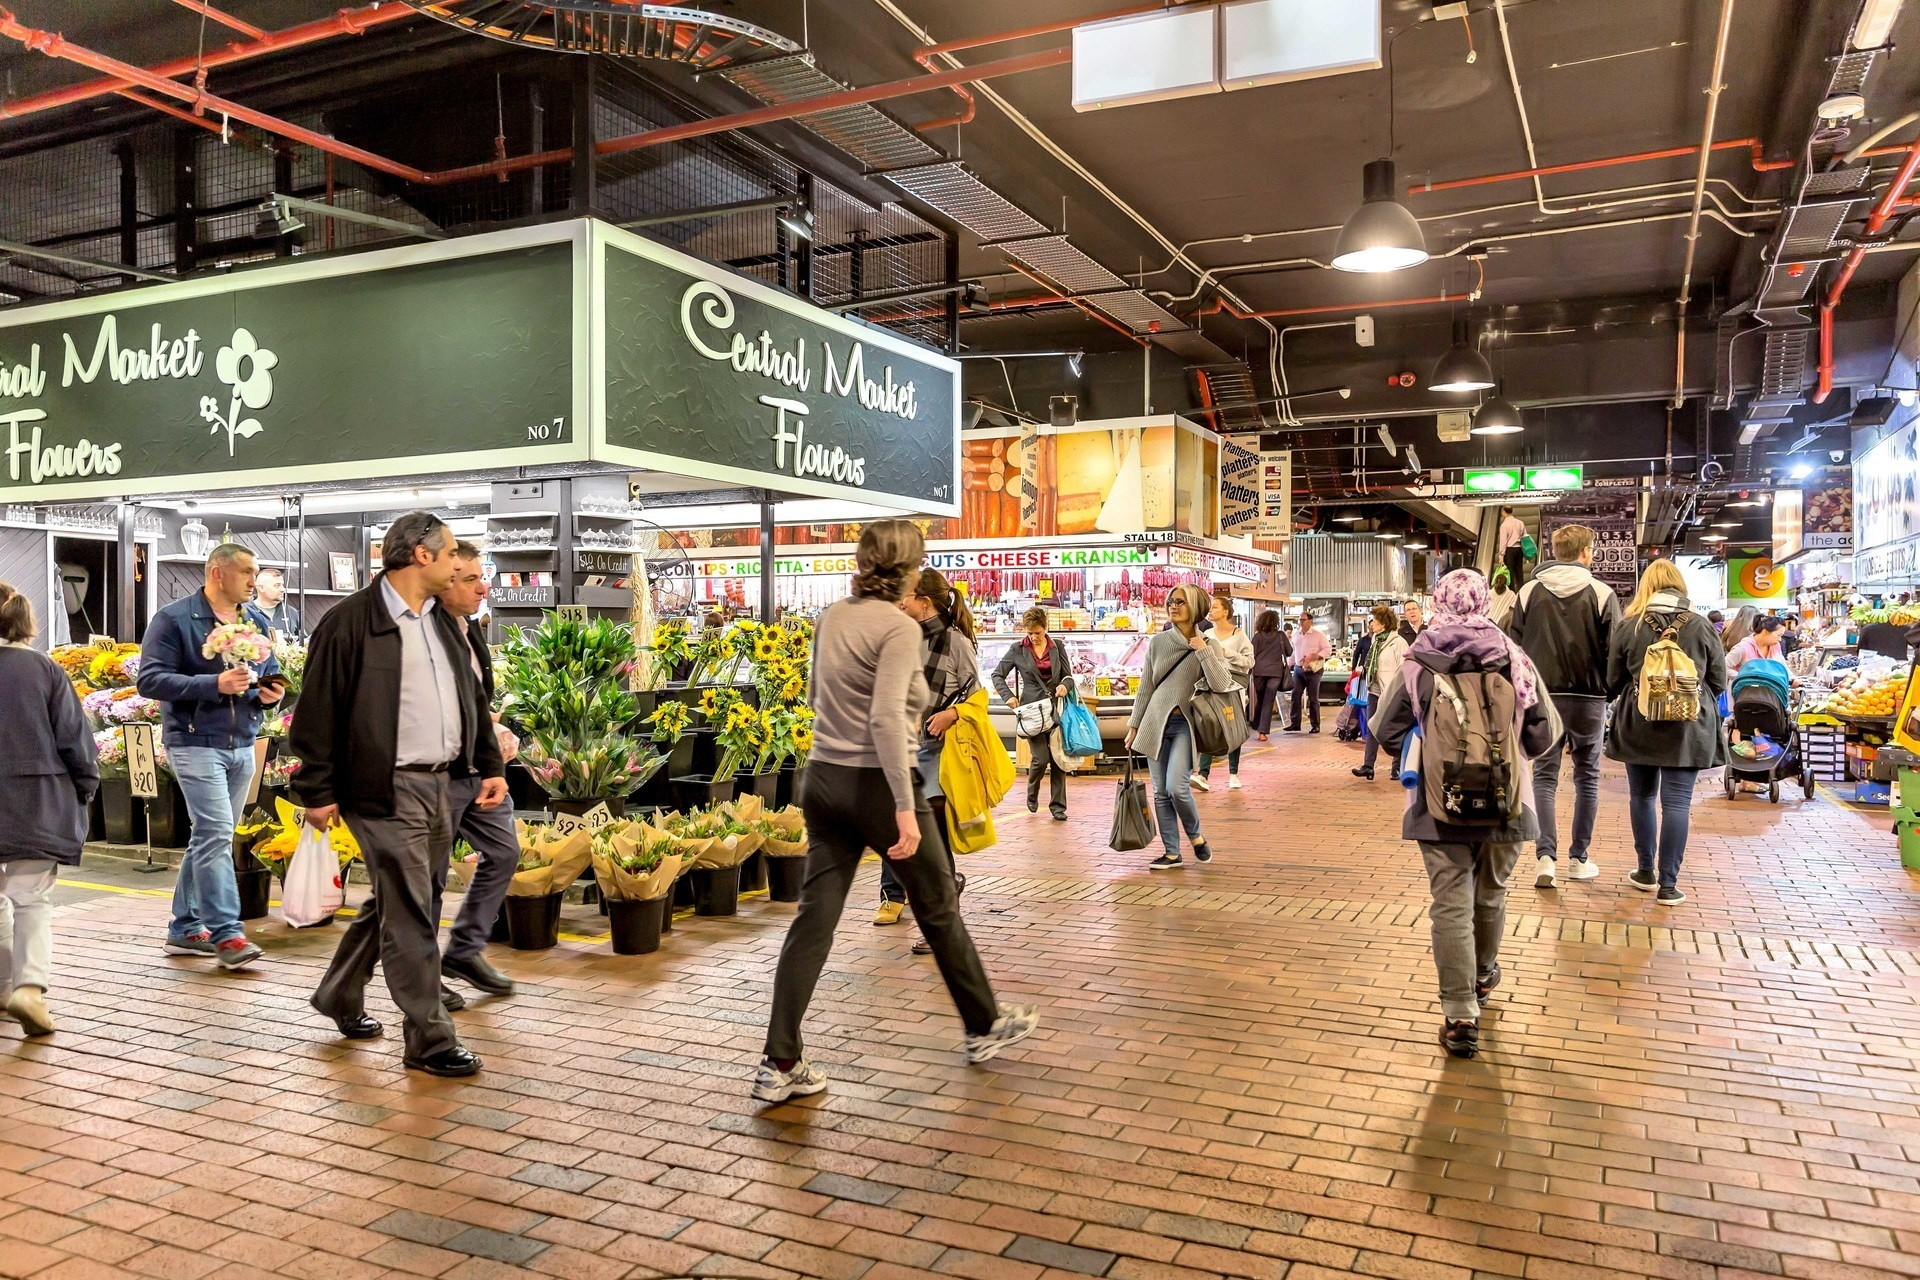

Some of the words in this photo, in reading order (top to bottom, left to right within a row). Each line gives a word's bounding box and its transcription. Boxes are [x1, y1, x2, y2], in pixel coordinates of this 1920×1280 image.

[62, 314, 204, 388] Market
[681, 280, 810, 392] Central
[824, 341, 918, 420] Market
[527, 424, 550, 440] NO
[552, 417, 565, 439] 7
[0, 408, 122, 484] Flowers
[759, 395, 865, 486] Flowers
[1221, 454, 1259, 478] platters
[1221, 481, 1259, 506] Platters
[1221, 506, 1259, 530] platters
[1124, 533, 1158, 543] STALL
[1160, 532, 1173, 541] 18
[1811, 535, 1833, 545] the
[977, 551, 1051, 567] CHEESE
[1061, 549, 1149, 565] KRANSKI
[1174, 549, 1197, 566] CHEESE
[1199, 554, 1215, 569] FRITZ
[1217, 558, 1236, 573] OLIVES
[1592, 548, 1634, 562] 966
[661, 563, 695, 577] CON
[736, 560, 803, 575] RICTTA
[813, 558, 857, 573] EGGS
[507, 589, 518, 602] On
[519, 587, 548, 602] Credit
[561, 608, 583, 622] $18
[784, 618, 799, 631] $15
[134, 725, 143, 746] 2
[133, 770, 154, 793] $20
